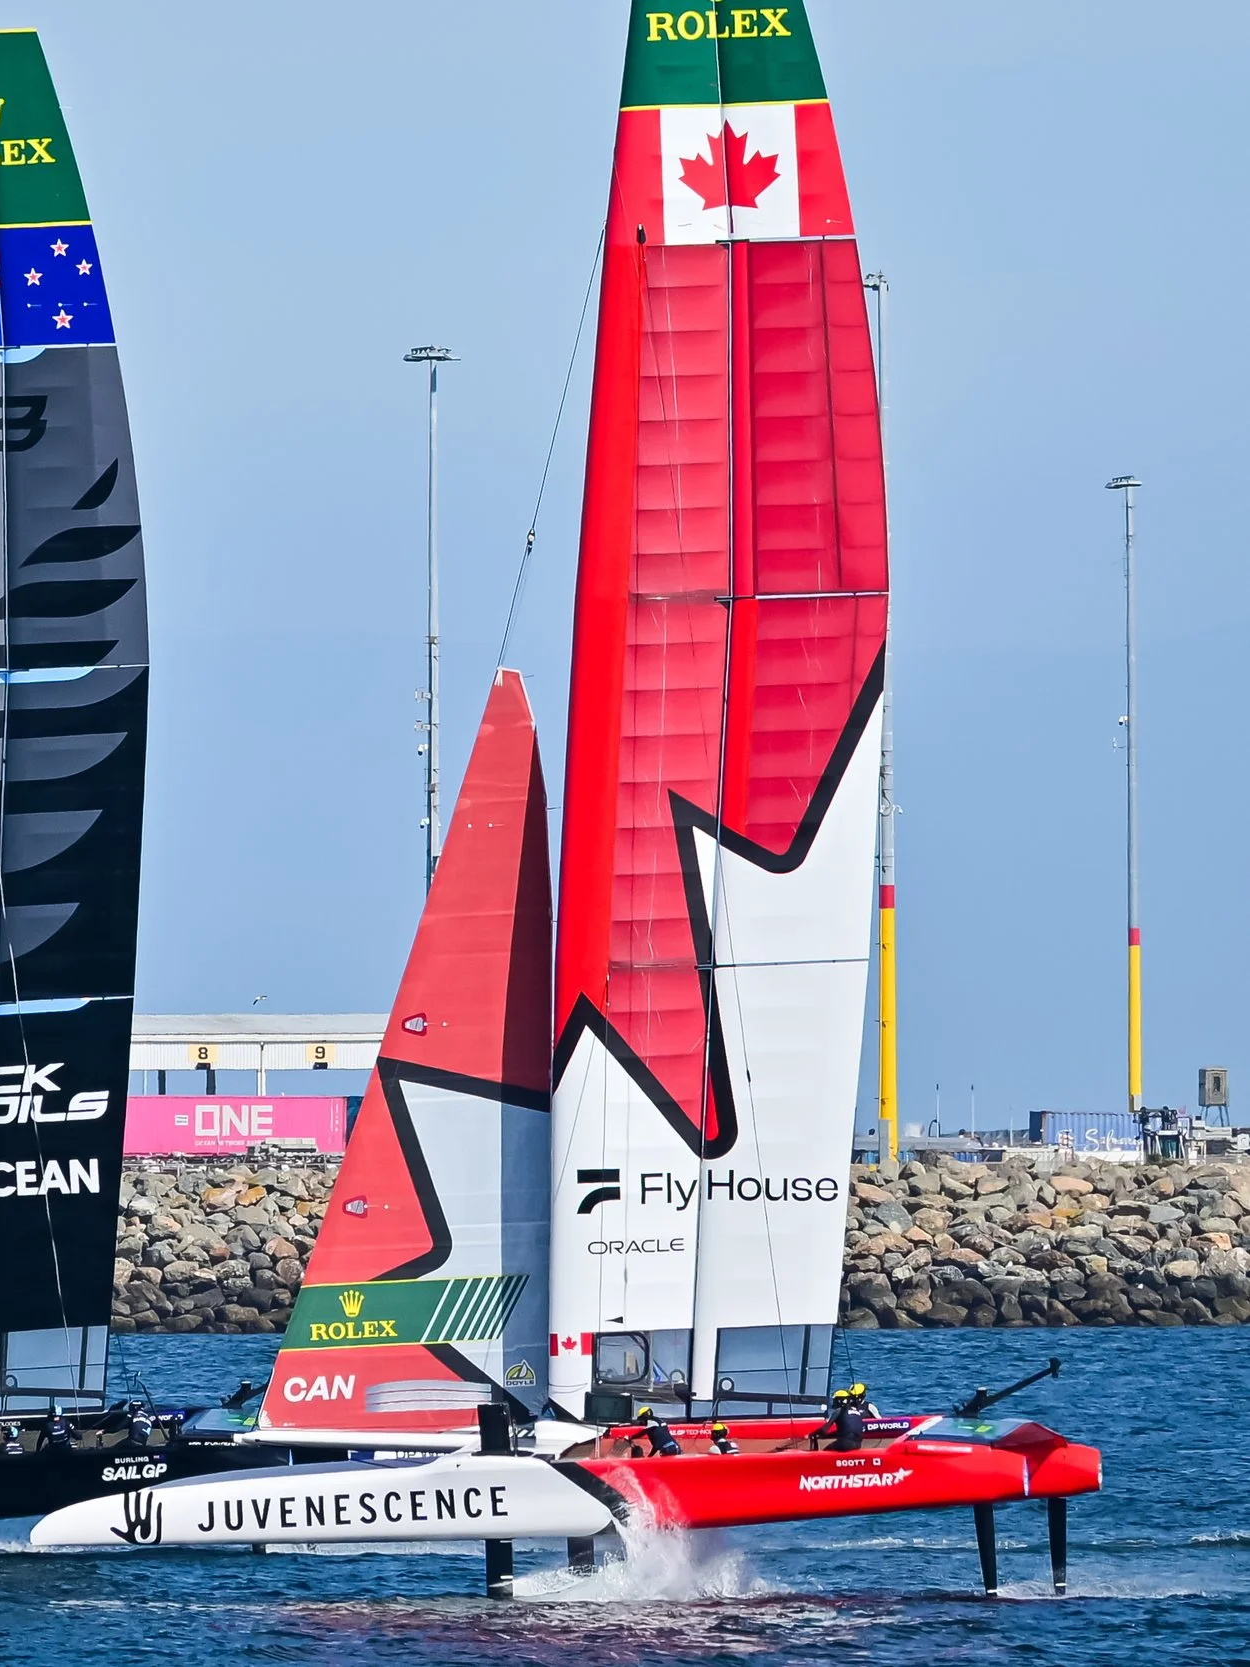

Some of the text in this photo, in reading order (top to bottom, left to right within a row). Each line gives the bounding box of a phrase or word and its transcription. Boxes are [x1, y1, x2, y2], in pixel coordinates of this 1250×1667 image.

[646, 8, 792, 41] ROLEX
[198, 1047, 208, 1060] 8
[315, 1046, 326, 1059] 9
[195, 1104, 273, 1137] ONE
[587, 1237, 685, 1255] ORACLE
[309, 1319, 398, 1341] ROLEX
[283, 1374, 355, 1402] CAN
[505, 1379, 536, 1387] DOYLE
[880, 1422, 909, 1430] WORLD
[115, 1456, 149, 1464] BURLING
[836, 1459, 865, 1467] SCOTT
[101, 1463, 168, 1481] SAILGP
[799, 1471, 895, 1492] NORTHSTAR
[197, 1486, 509, 1532] JUVENESCENCE
